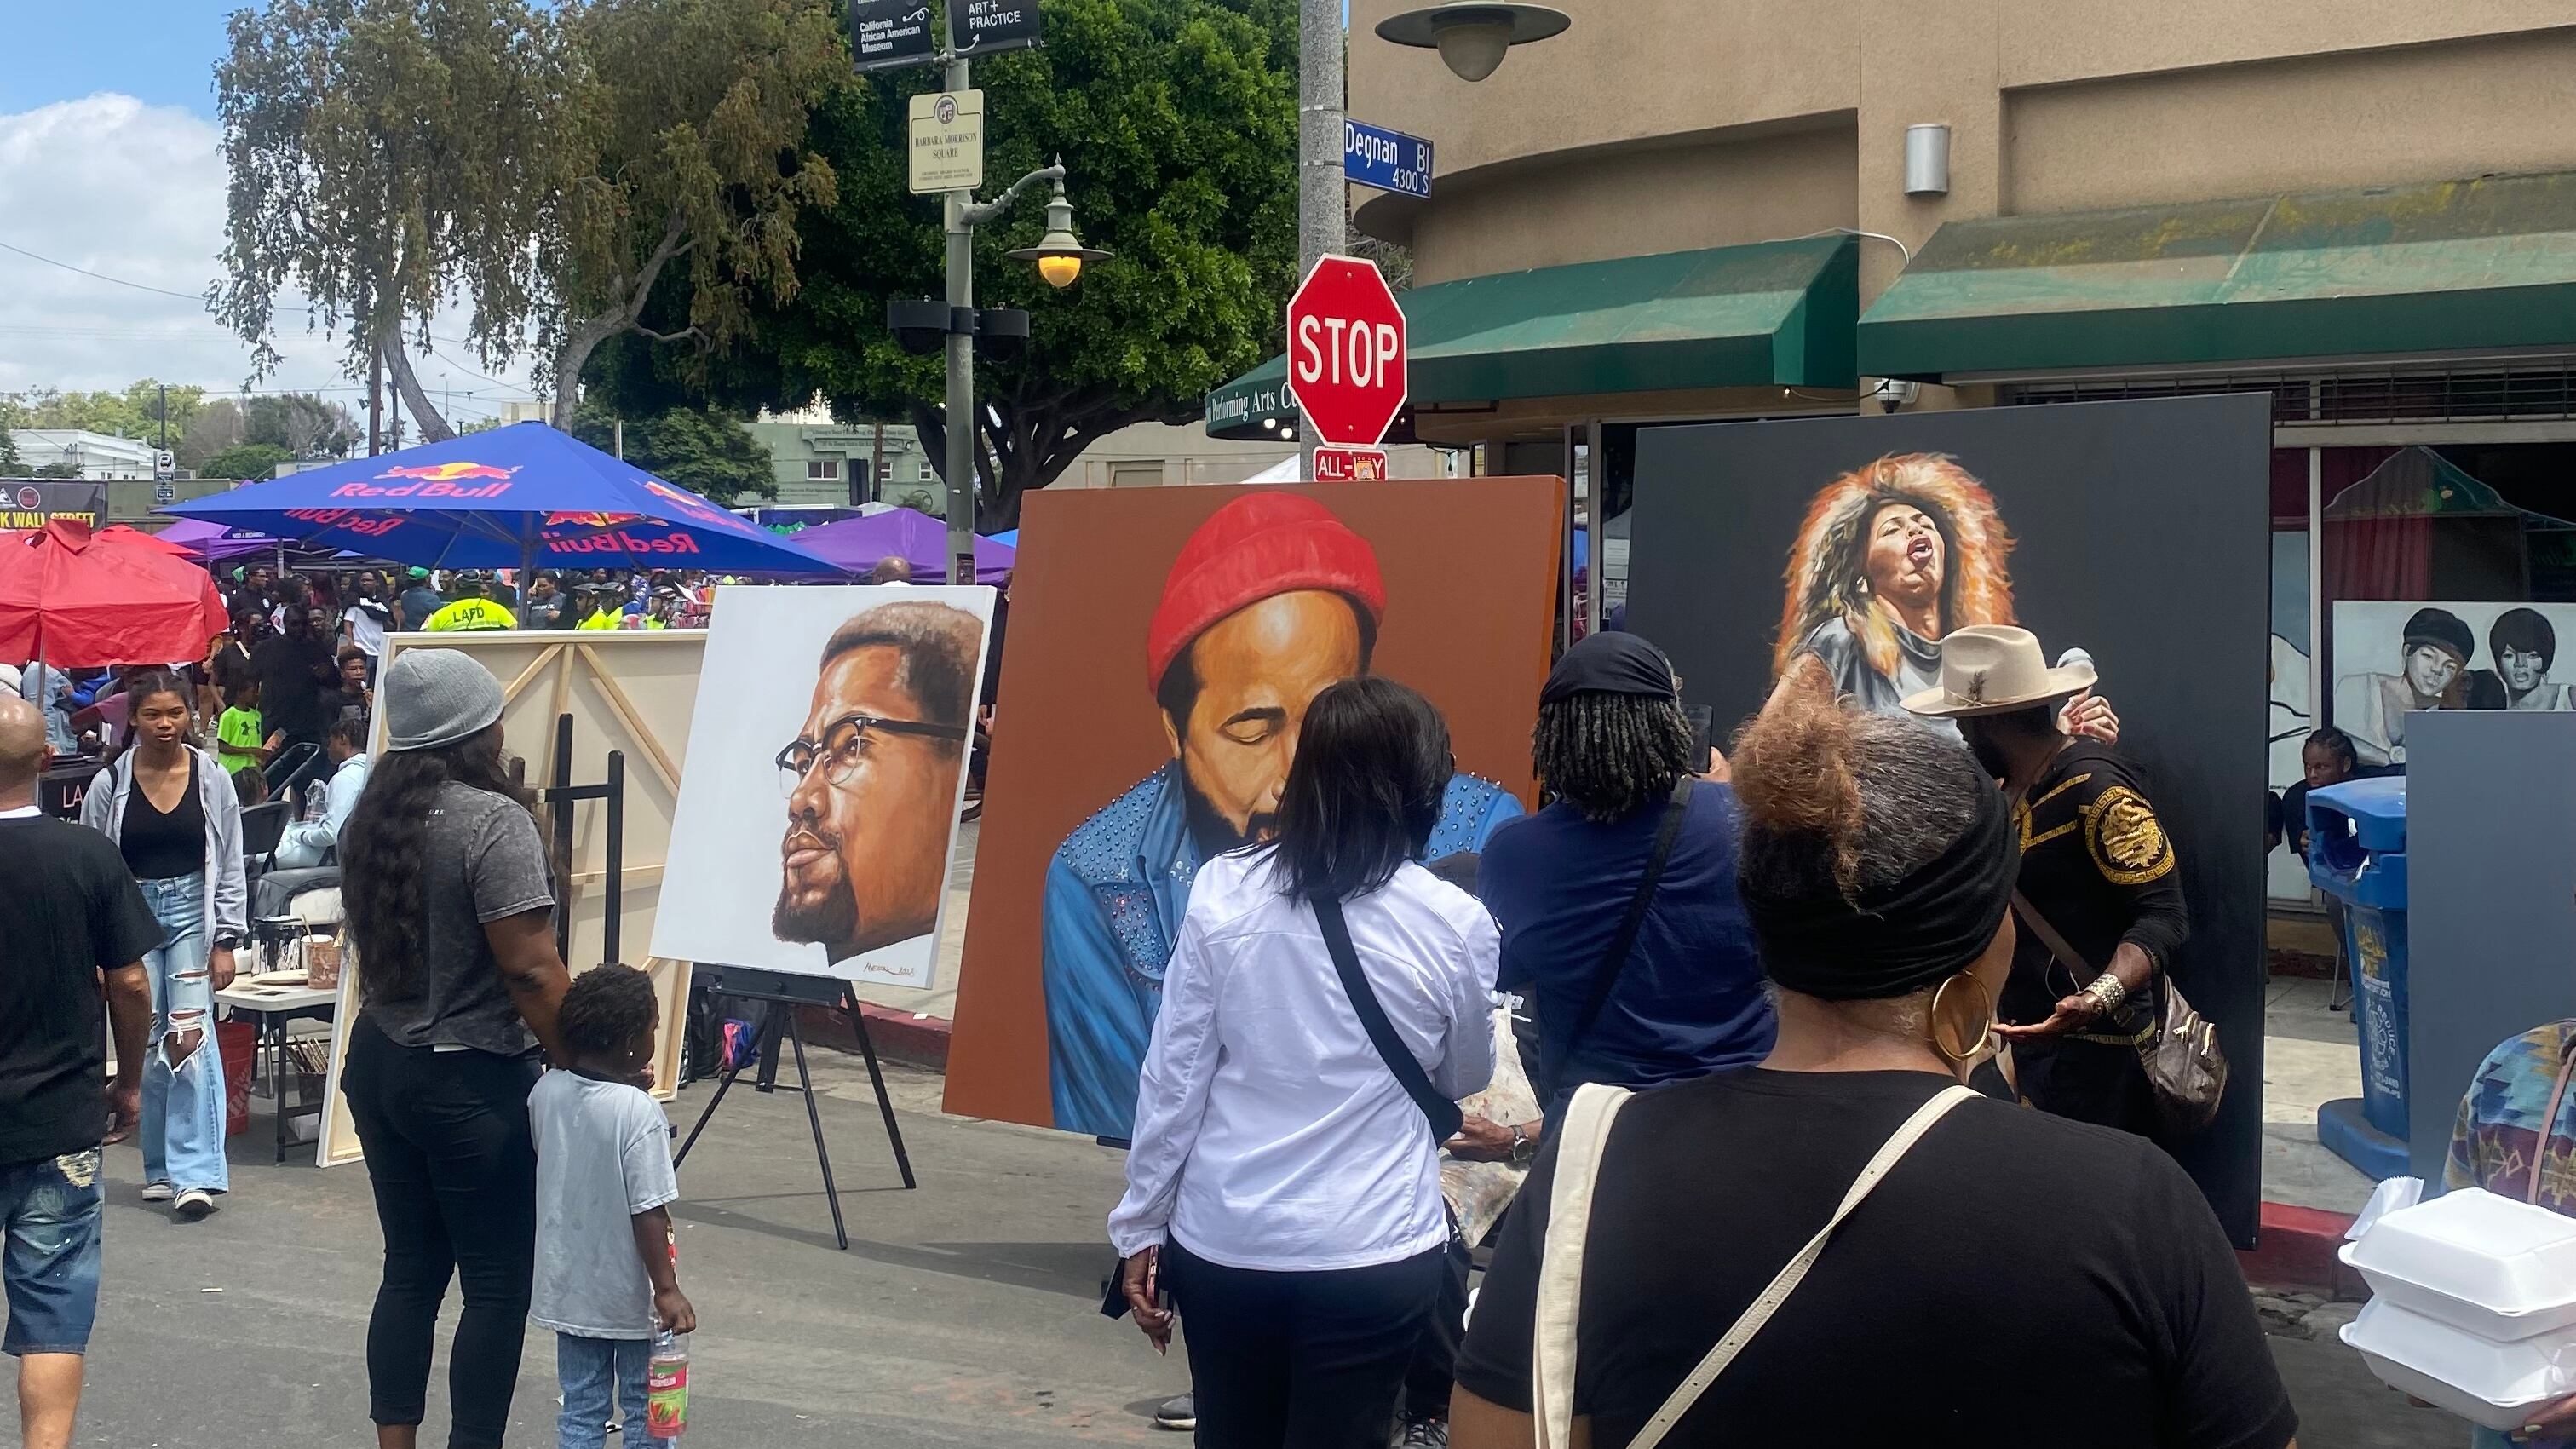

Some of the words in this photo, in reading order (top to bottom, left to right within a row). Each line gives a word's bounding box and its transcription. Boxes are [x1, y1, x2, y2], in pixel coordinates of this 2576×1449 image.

[859, 19, 894, 32] California
[969, 10, 1021, 30] PRACTICE
[860, 32, 887, 43] African
[887, 26, 921, 39] American
[862, 41, 894, 54] Museum
[915, 135, 944, 147] BARBARA
[944, 132, 977, 145] MORRISON
[932, 147, 958, 161] SQUARE
[1345, 122, 1398, 169] Degnan
[1417, 142, 1430, 175] Bl
[1392, 167, 1418, 192] 4300
[1422, 174, 1429, 194] S
[1297, 314, 1399, 388] STOP
[1210, 391, 1249, 422] Performing
[1251, 388, 1276, 414] Arts
[1317, 455, 1383, 479] ALL-Y
[329, 481, 424, 498] Red
[417, 481, 513, 498] Bull
[452, 607, 485, 623] LAPD
